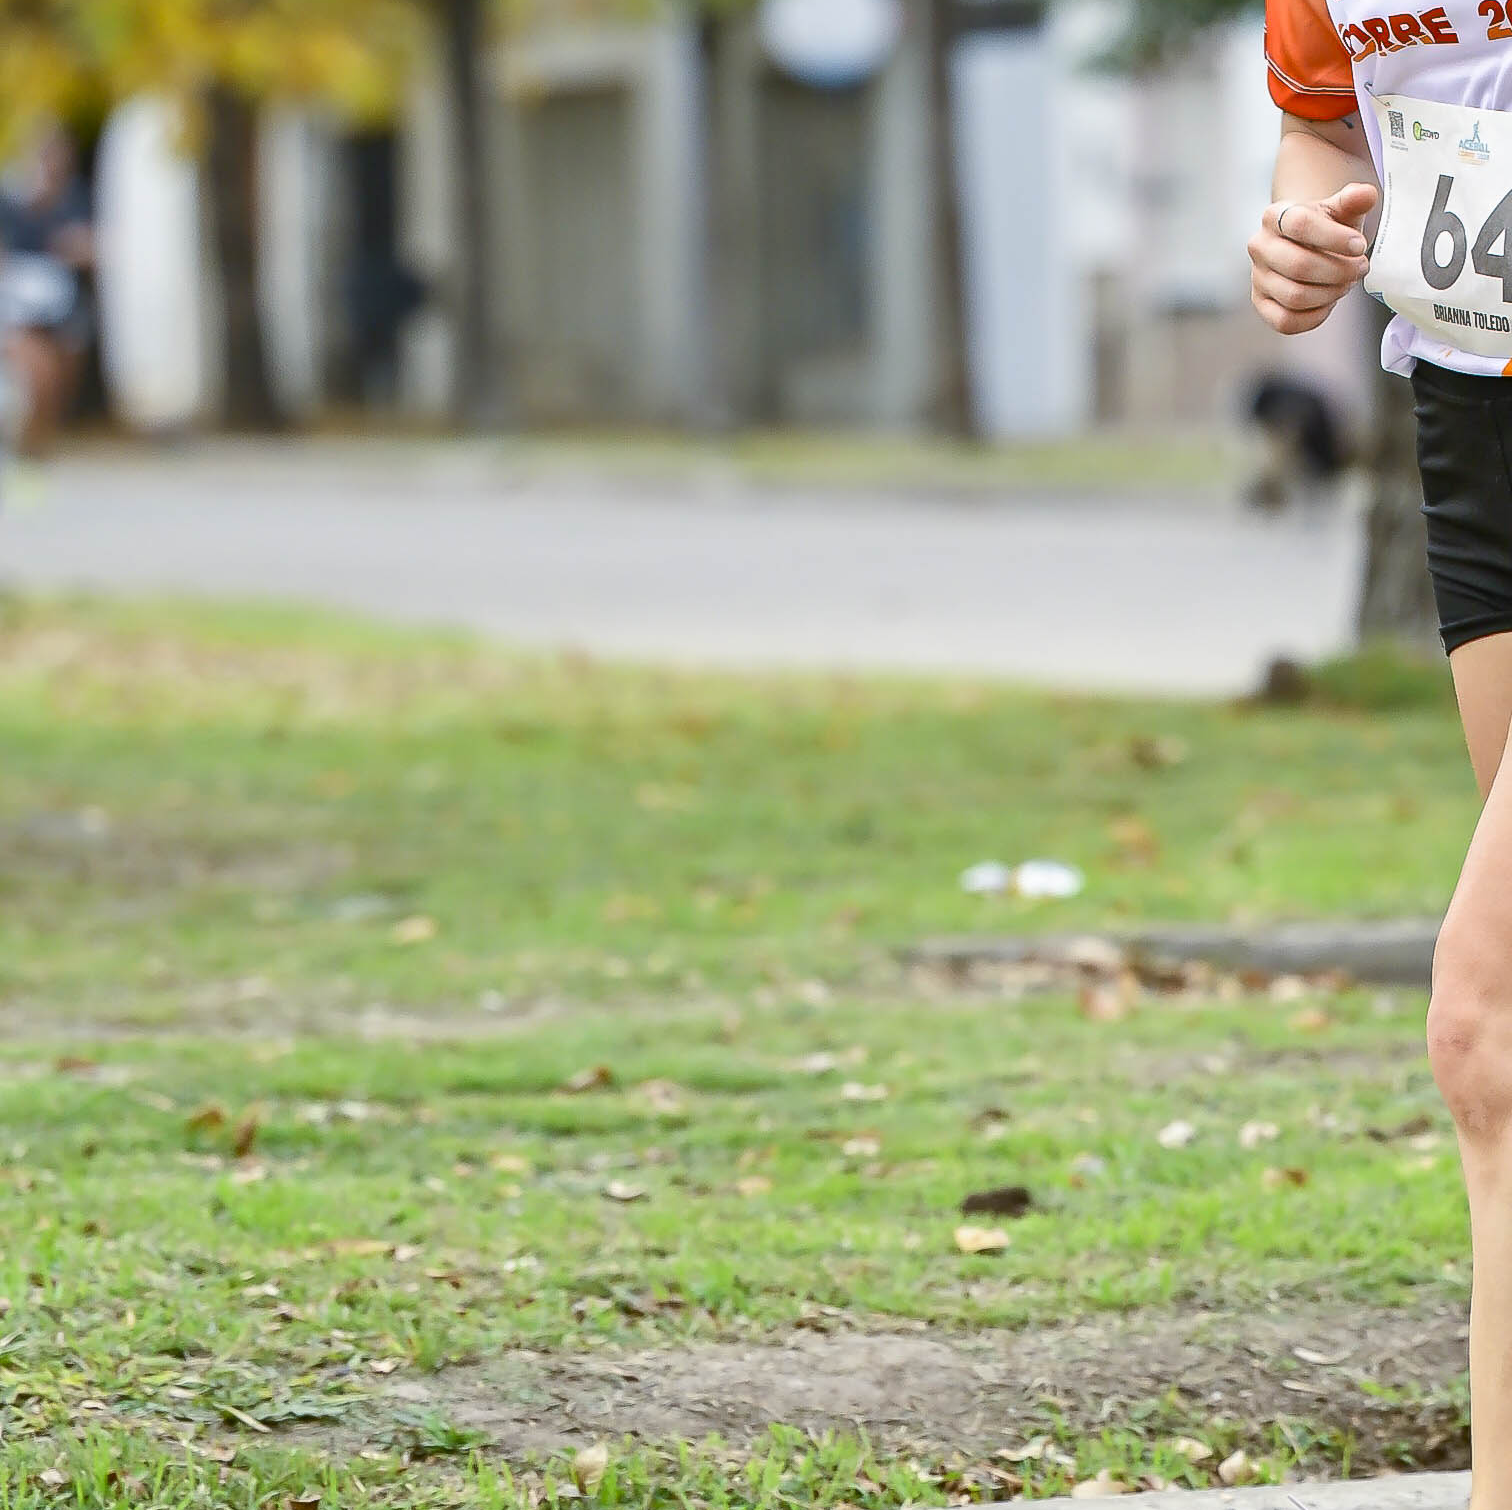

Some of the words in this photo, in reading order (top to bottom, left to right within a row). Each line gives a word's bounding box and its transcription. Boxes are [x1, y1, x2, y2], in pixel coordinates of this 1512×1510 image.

[1339, 7, 1460, 62] ORRE
[1433, 304, 1471, 327] BRIANNA
[1473, 311, 1511, 333] TOLEDO
